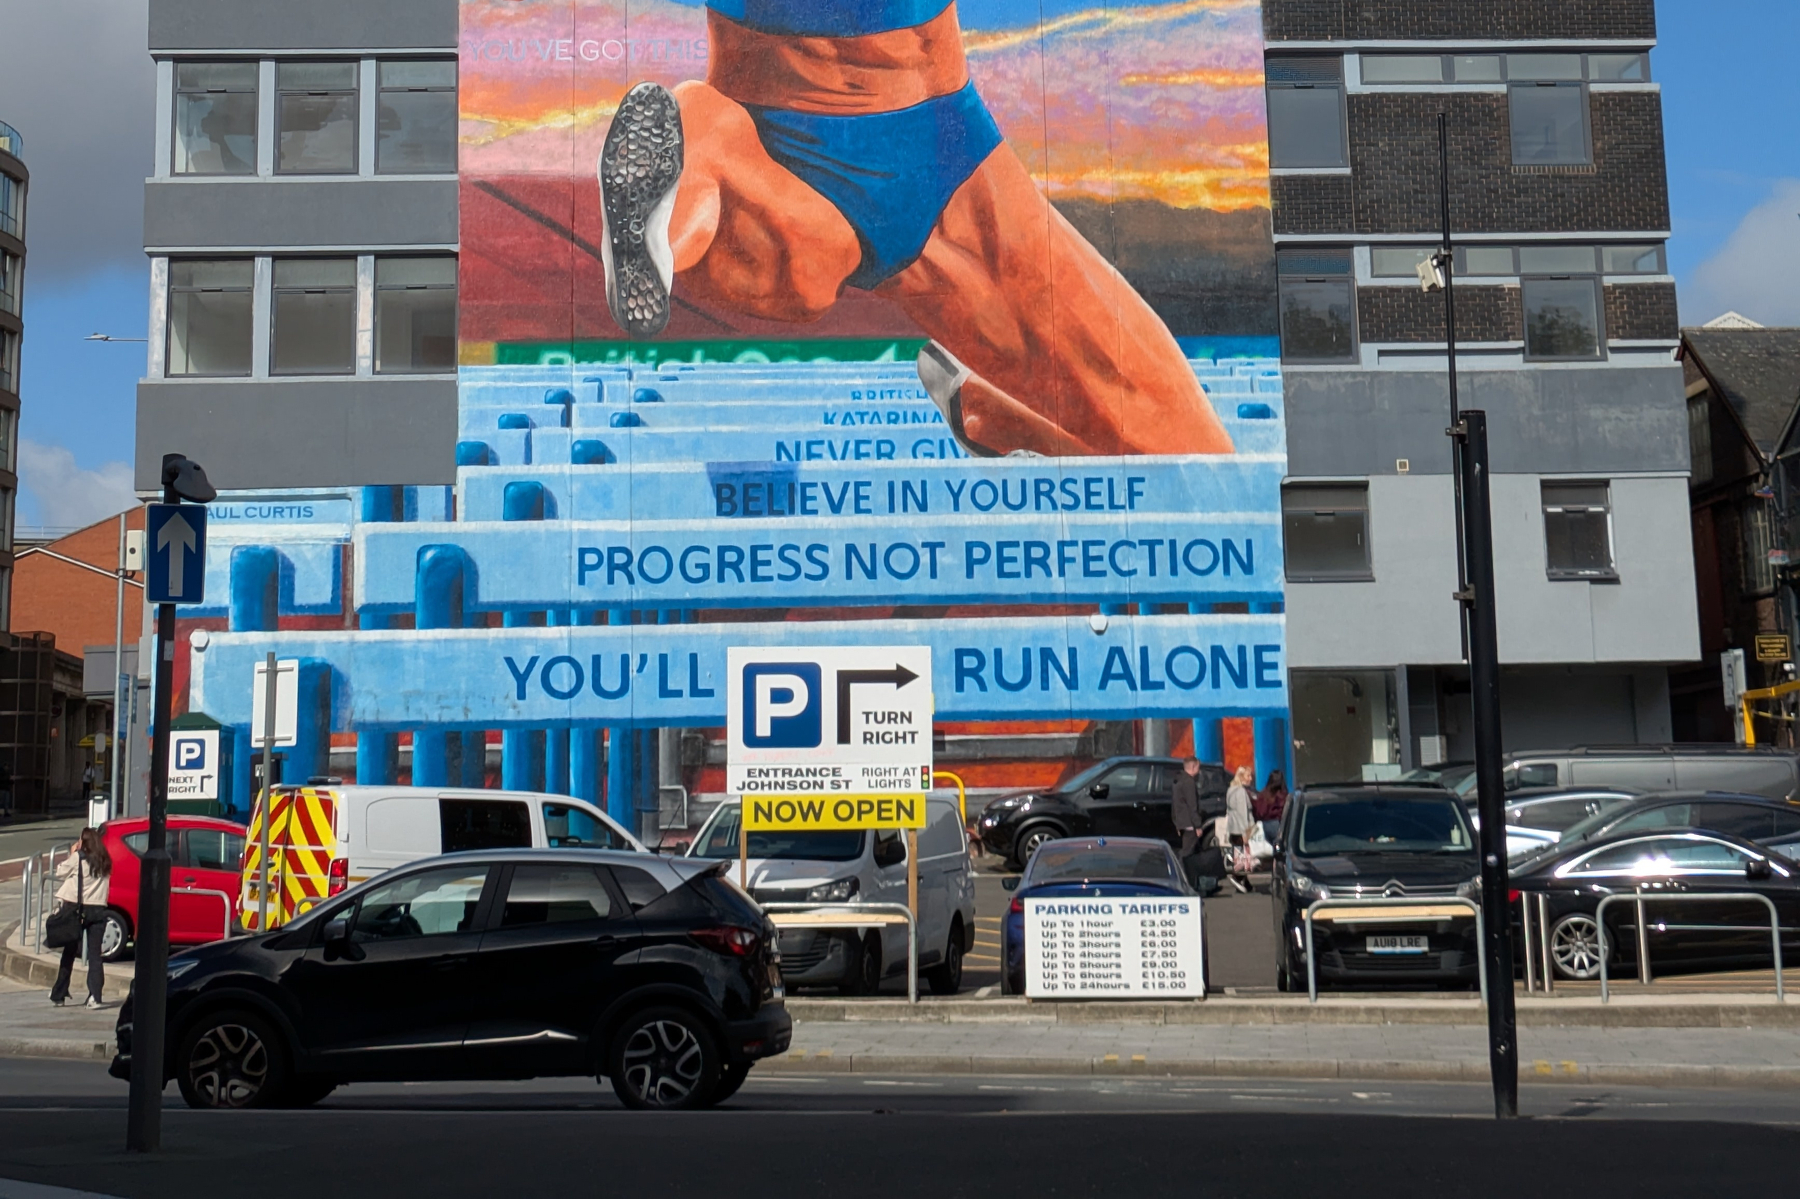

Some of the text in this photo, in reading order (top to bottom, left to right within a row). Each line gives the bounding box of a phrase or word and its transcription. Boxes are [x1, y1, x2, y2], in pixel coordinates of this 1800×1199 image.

[466, 39, 709, 62] YOU'VE GOT THIS
[823, 411, 943, 426] KATARINA
[775, 439, 896, 462] NEVER
[715, 477, 1145, 517] BELIEVE IN YOURSELF
[206, 505, 314, 519] AUL CURTIS
[577, 537, 1254, 586] PROGRESS NOT PERFECTION
[503, 644, 1283, 701] YOU'LL RUN ALONE
[755, 673, 809, 738] P
[862, 711, 912, 724] TURN
[862, 731, 919, 745] RIGHT
[180, 742, 201, 767] P
[746, 767, 842, 778] ENTRANCE
[862, 767, 918, 777] RIGHT AT
[736, 779, 852, 791] JOHNSON ST
[868, 778, 912, 789] LIGHTS
[168, 786, 197, 794] RIGHT
[753, 799, 915, 823] NOW OPEN
[1035, 903, 1190, 915] PARKING TARIFFS
[1041, 920, 1057, 929] Up
[1140, 919, 1176, 927] £3.00
[1041, 930, 1057, 939] Up
[1042, 940, 1057, 949] Up
[1061, 940, 1075, 948] To
[1400, 937, 1421, 947] LRE
[1042, 951, 1057, 960] Up
[1141, 950, 1177, 958] £7.50
[1042, 961, 1057, 970] Up
[1042, 971, 1058, 980] Up
[1062, 971, 1075, 979] To
[1043, 982, 1058, 990] Up
[1142, 981, 1186, 989] £15.00
